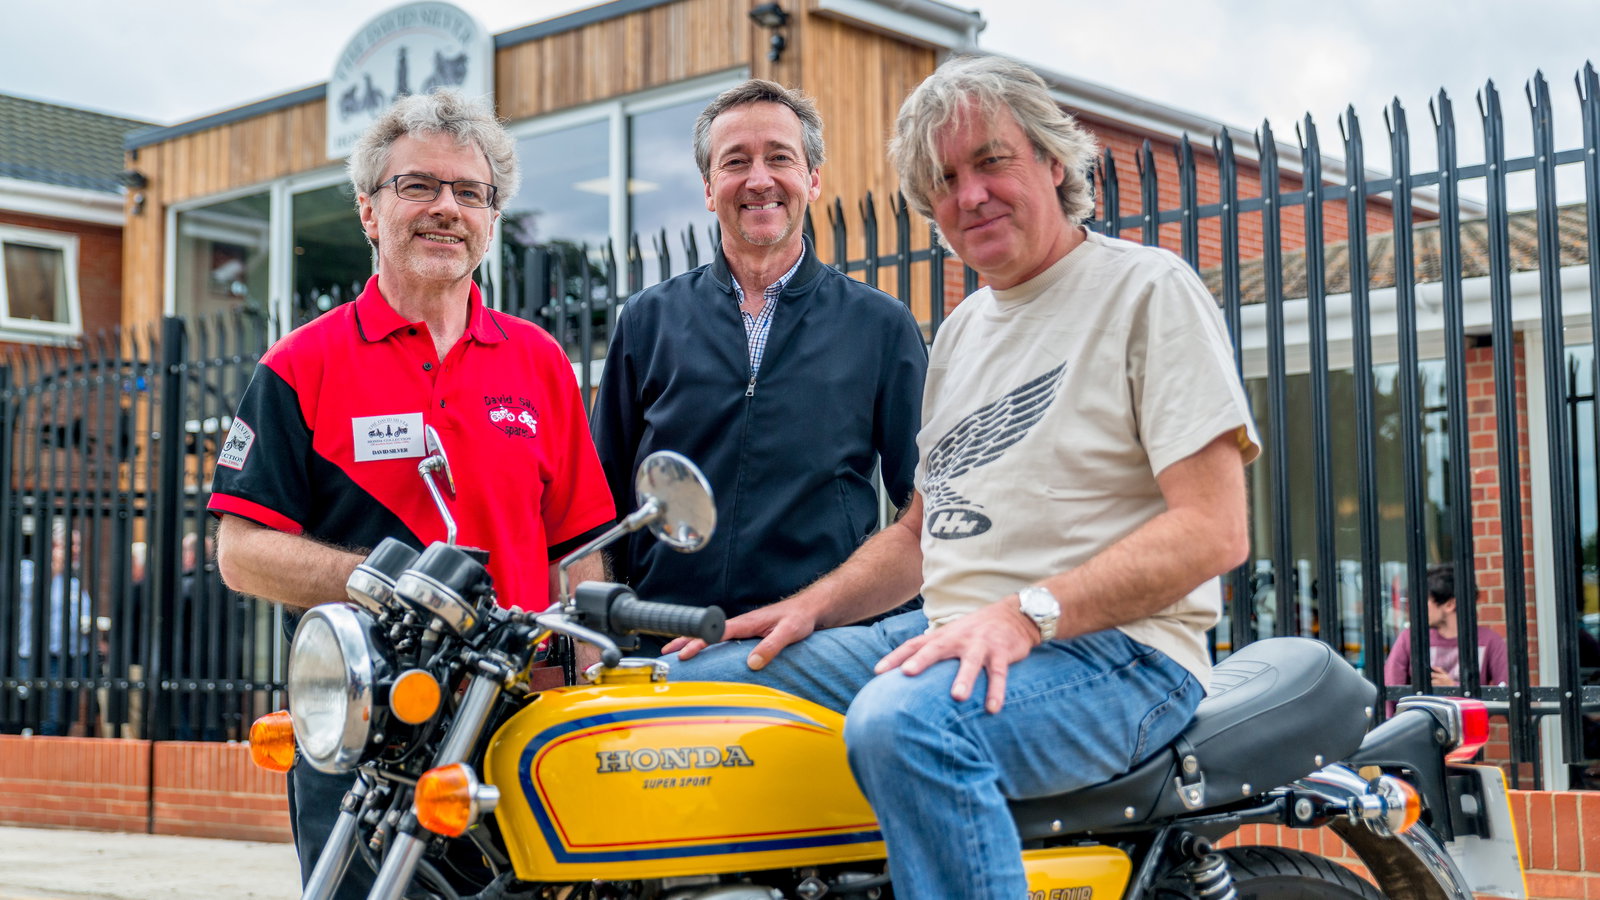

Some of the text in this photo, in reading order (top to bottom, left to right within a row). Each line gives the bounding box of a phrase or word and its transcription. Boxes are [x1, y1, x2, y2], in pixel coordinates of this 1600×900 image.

[484, 394, 513, 406] David
[596, 745, 754, 774] HONDA
[642, 776, 712, 789] SUPER SPORT
